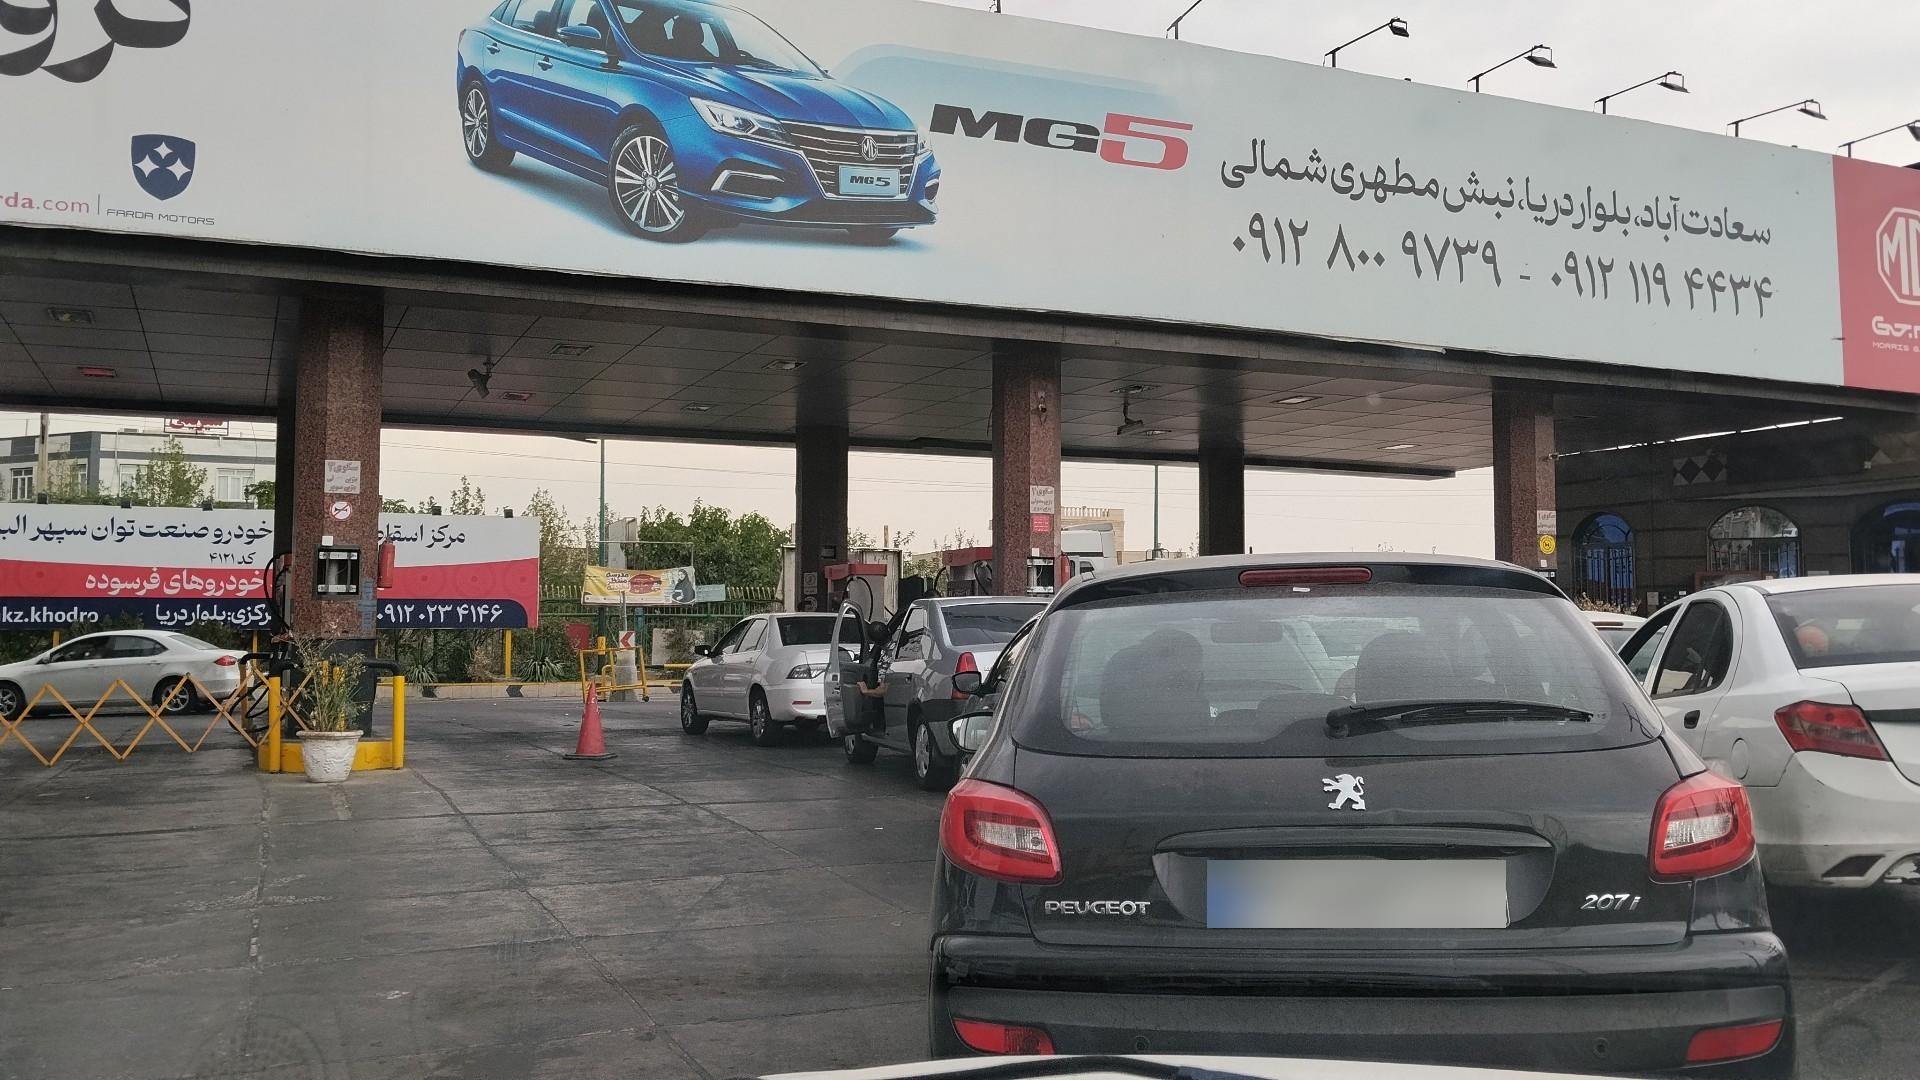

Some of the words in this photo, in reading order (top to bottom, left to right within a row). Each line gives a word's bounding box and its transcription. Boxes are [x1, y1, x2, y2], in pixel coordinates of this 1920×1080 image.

[929, 102, 1194, 172] MG5
[1220, 137, 1327, 189] شمالی
[848, 174, 892, 188] MG5
[1330, 156, 1440, 204] مطهری
[1443, 170, 1515, 221] نبش
[106, 208, 154, 220] FARDA
[158, 213, 215, 226] MOTORS
[1571, 185, 1632, 237] بلوار
[1681, 206, 1772, 246] سعادت
[28, 520, 88, 544] سپهر
[91, 516, 136, 544] توان
[138, 521, 209, 539] صنعت
[210, 519, 274, 545] خودرو
[425, 523, 466, 549] مرکز
[236, 551, 257, 566] کد
[85, 567, 161, 597] فرسوده
[163, 568, 265, 598] خودروهای
[154, 603, 188, 626] دریا
[1044, 900, 1151, 915] PEUGEOT
